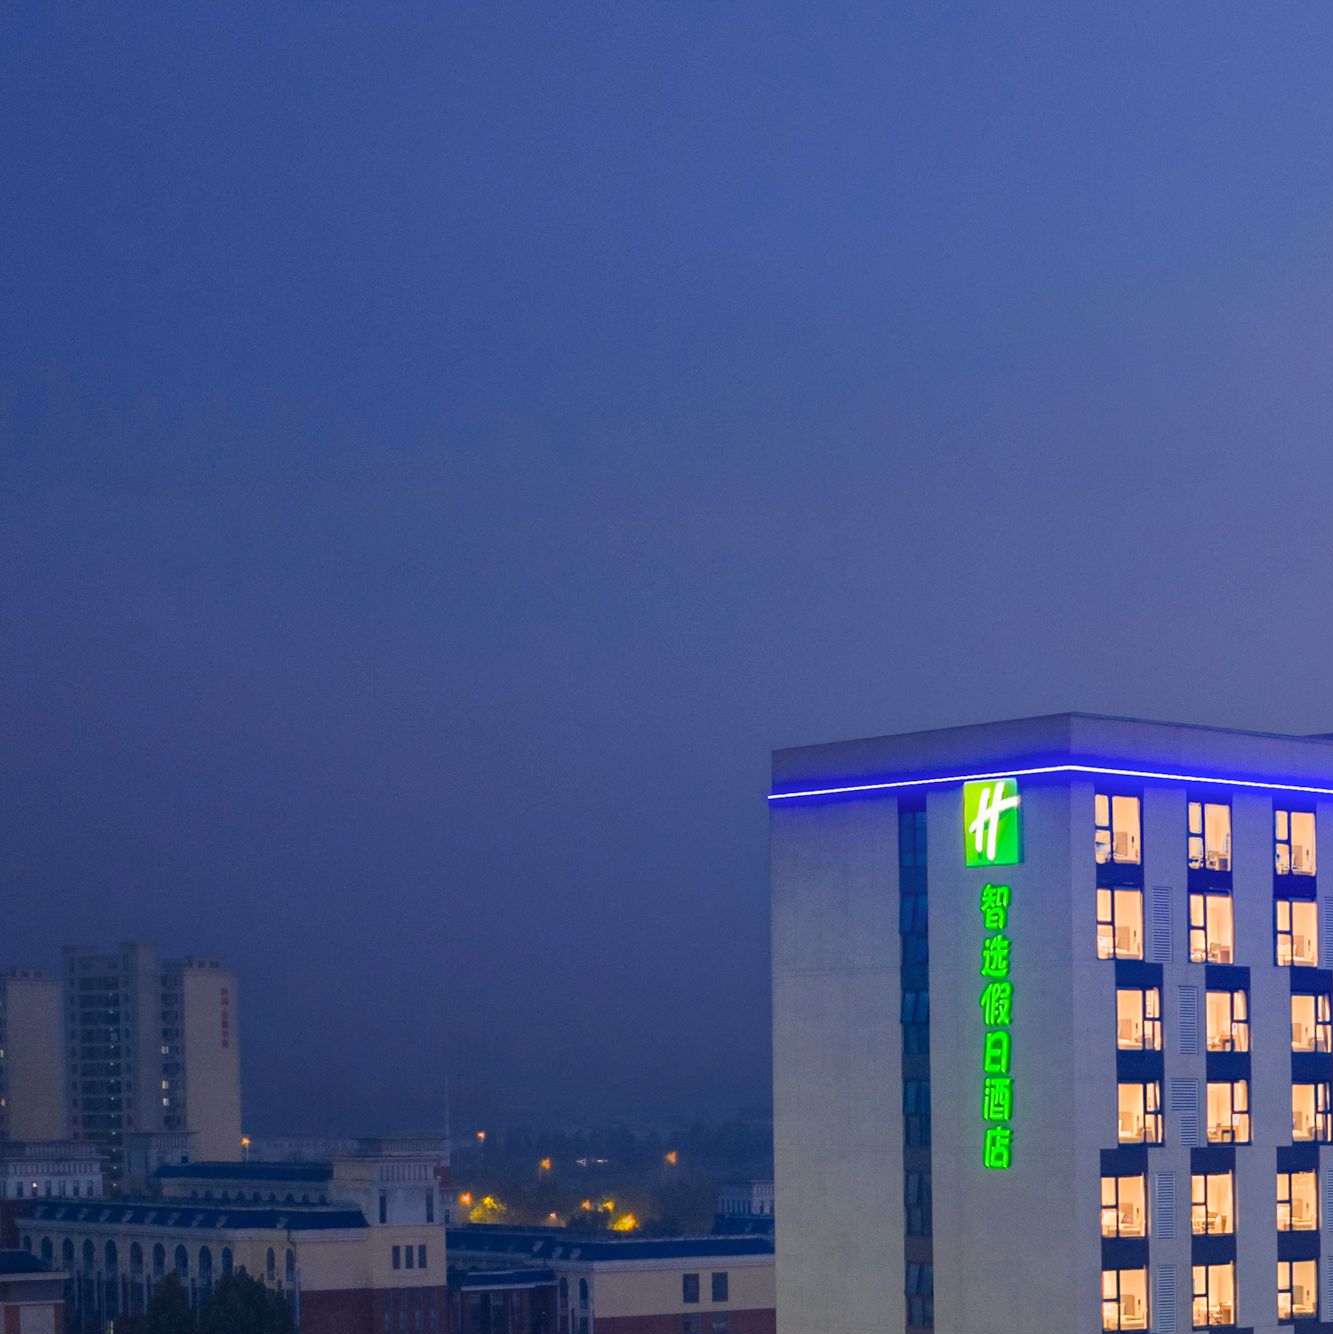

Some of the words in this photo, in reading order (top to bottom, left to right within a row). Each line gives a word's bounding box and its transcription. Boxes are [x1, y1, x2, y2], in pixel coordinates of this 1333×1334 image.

[979, 882, 1014, 1170] 智选假日酒店
